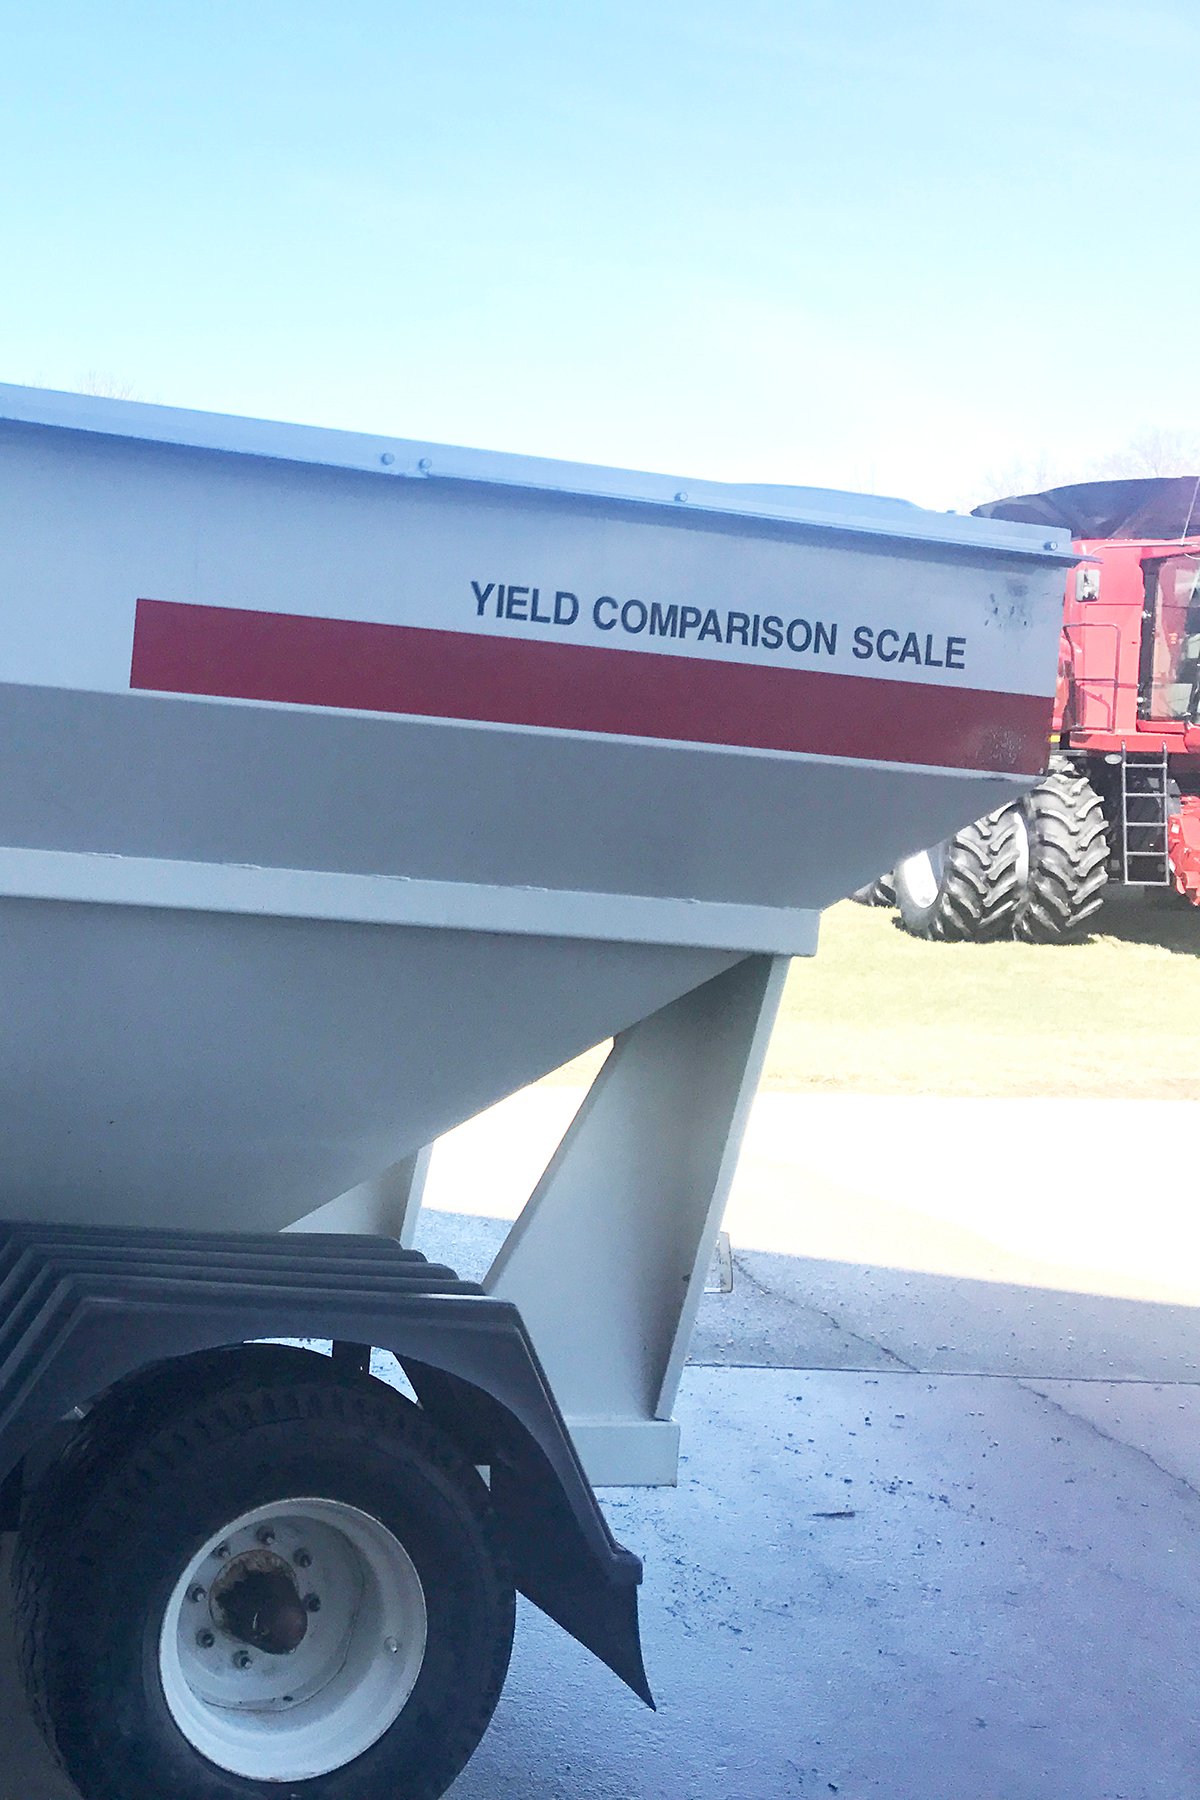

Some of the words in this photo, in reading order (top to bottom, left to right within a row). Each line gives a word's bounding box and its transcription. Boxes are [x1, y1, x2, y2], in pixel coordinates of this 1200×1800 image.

[470, 580, 580, 626] YIELD
[592, 595, 838, 656] COMPARISON
[851, 625, 968, 670] SCALE
